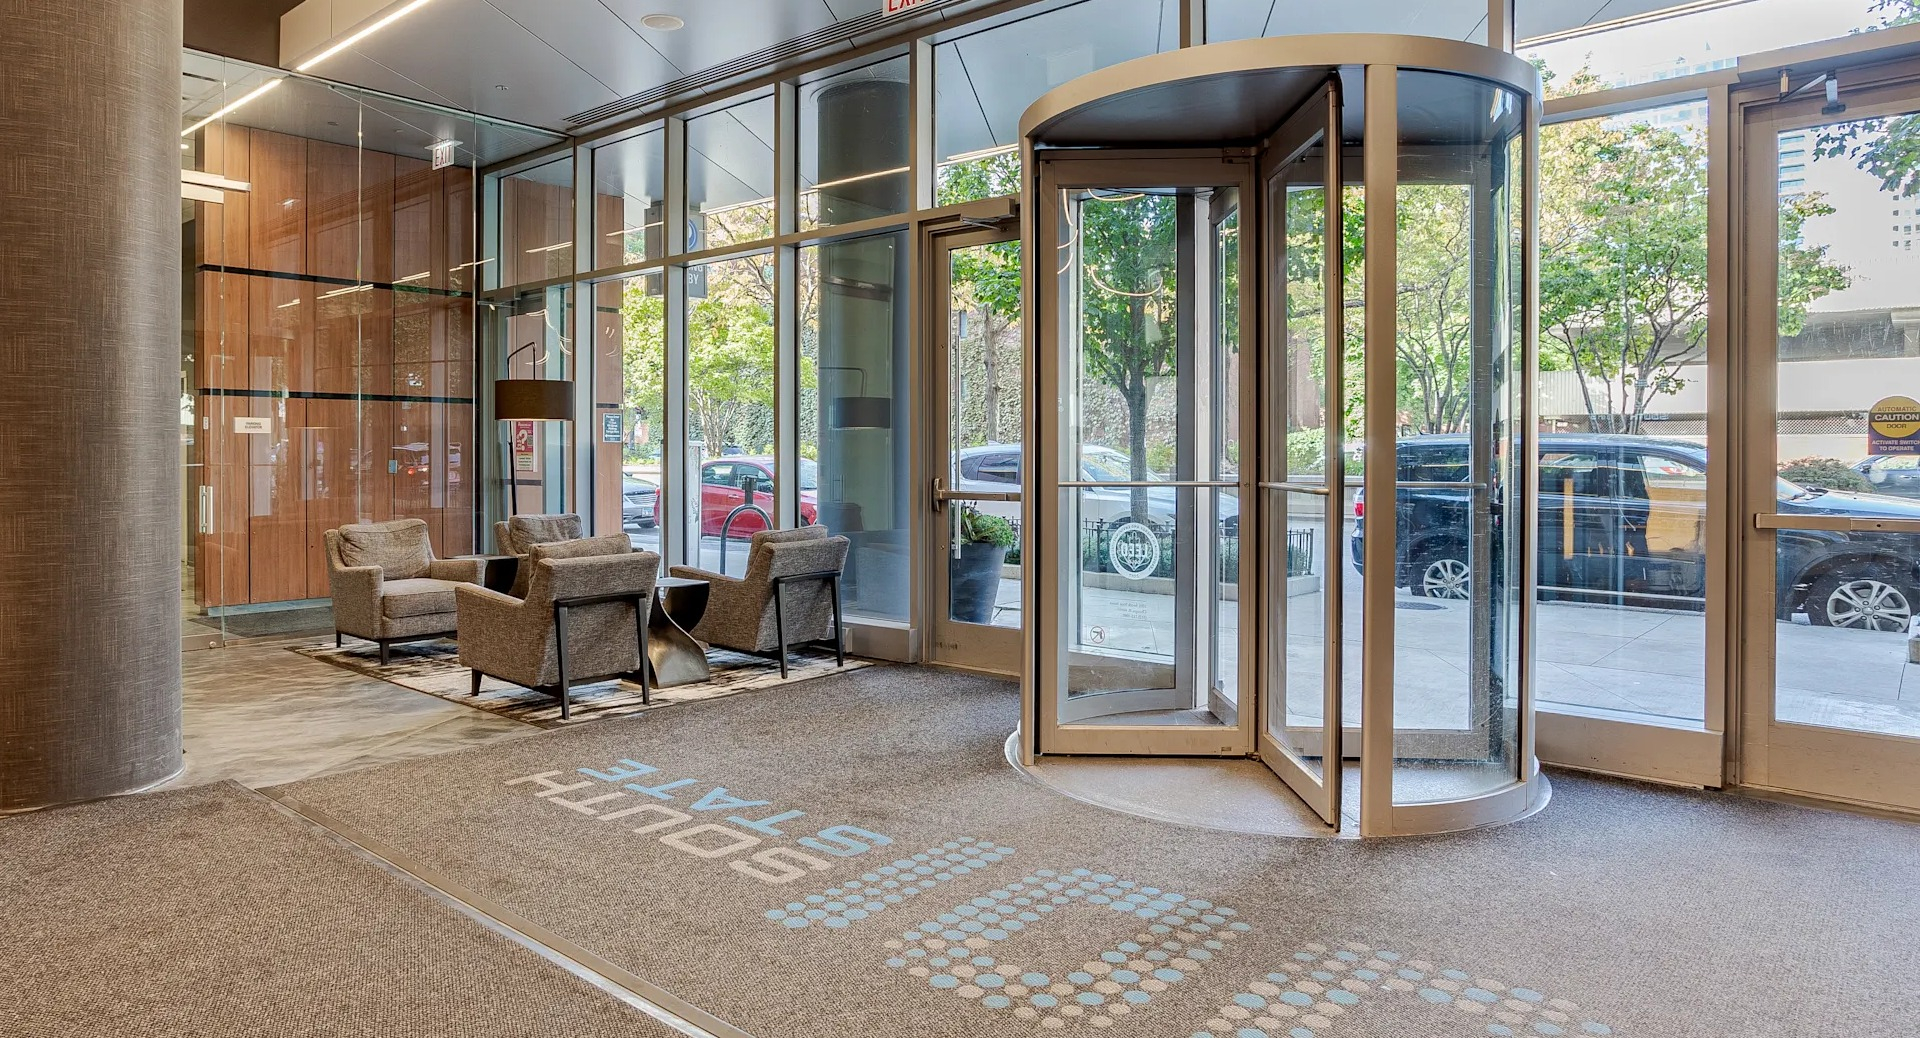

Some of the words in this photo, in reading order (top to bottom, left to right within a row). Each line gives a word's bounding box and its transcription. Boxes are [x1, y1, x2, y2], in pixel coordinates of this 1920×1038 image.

[435, 145, 452, 166] EXIT
[504, 769, 832, 884] SOUTH
[577, 757, 894, 858] STATE
